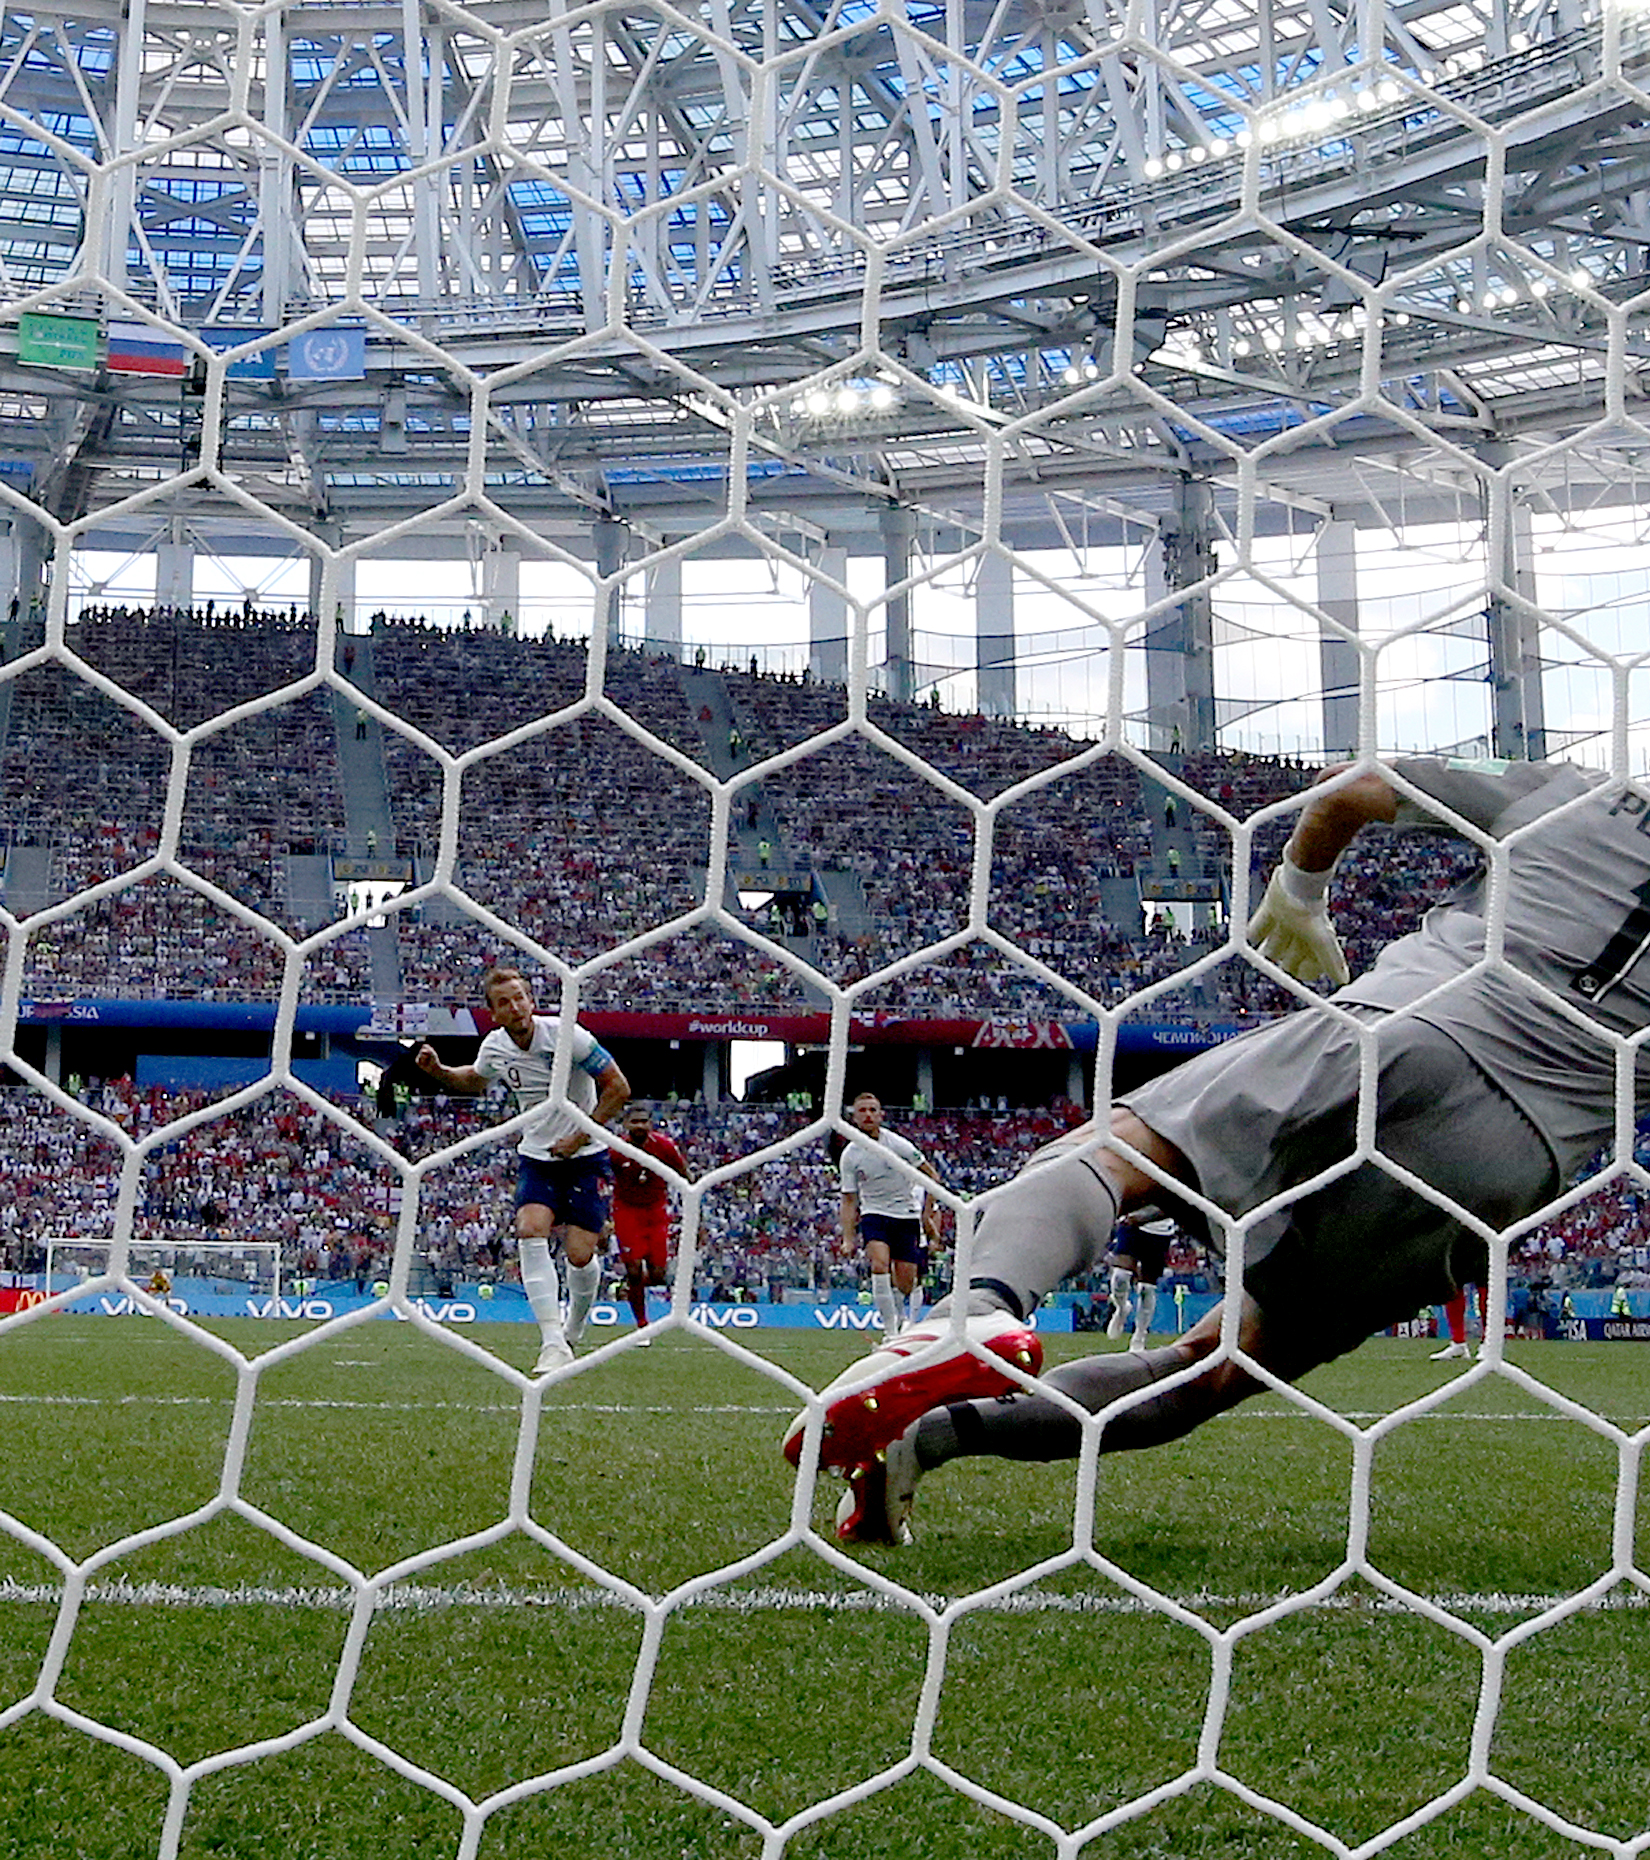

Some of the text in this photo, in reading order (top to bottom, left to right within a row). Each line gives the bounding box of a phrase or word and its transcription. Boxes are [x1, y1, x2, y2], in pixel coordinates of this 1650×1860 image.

[210, 344, 263, 364] FA
[688, 1019, 769, 1038] #worldcup
[508, 1067, 522, 1089] 9
[246, 1296, 333, 1319] vivo
